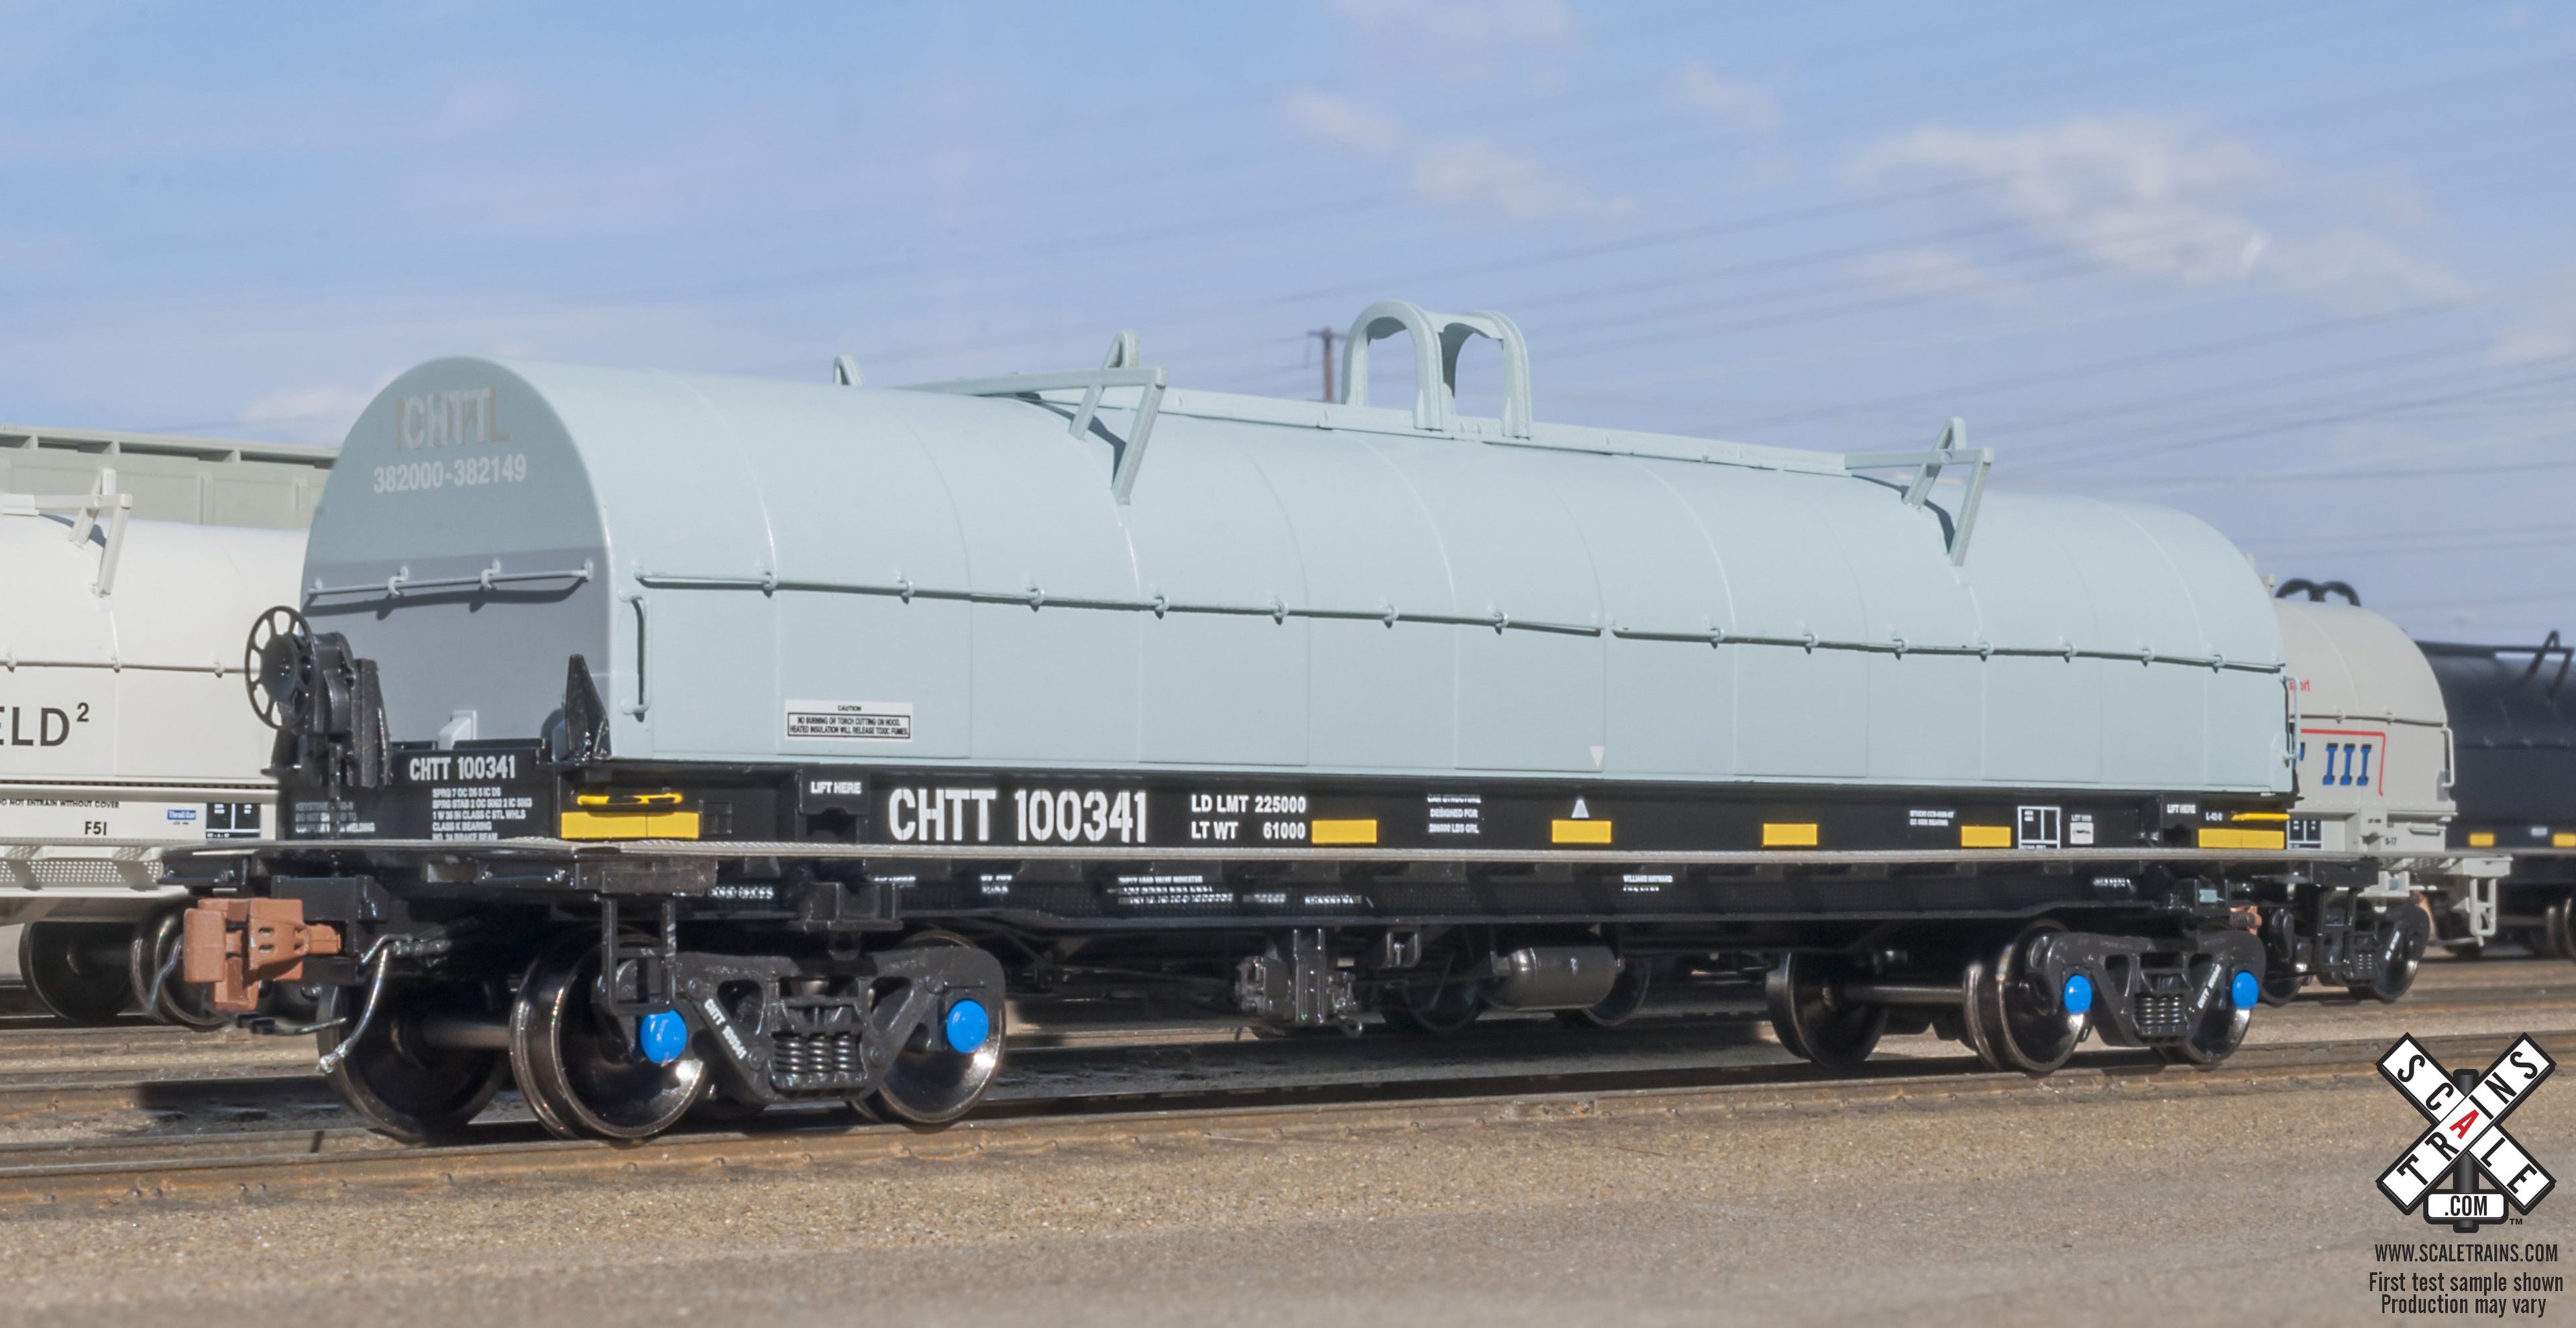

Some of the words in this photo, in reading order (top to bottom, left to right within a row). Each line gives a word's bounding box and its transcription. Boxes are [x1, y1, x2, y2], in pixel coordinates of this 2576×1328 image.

[374, 453, 527, 494] 382000-382149
[806, 716, 828, 724] BURNING
[838, 717, 854, 725] TORCH
[840, 726, 851, 734] WILL
[853, 726, 874, 734] RELEASE
[409, 757, 451, 781] CHTT
[458, 755, 516, 780] 100341
[811, 781, 833, 793] LIFT
[834, 781, 861, 793] HERE
[60, 799, 93, 808] WITHOUT
[1191, 794, 1212, 812] LD
[1216, 795, 1248, 812] LMT
[1254, 795, 1307, 813] 225000
[462, 810, 484, 820] CLASS
[492, 810, 505, 819] STL
[505, 810, 526, 819] WHLS
[889, 788, 997, 842] CHTT
[1015, 790, 1147, 844] 100341
[1430, 808, 1463, 818] DESIGNED
[432, 822, 454, 832] CLASS
[462, 821, 492, 831] BEARING
[1191, 822, 1210, 839] LT
[1213, 822, 1238, 839] WT
[1263, 822, 1307, 840] 61000
[704, 998, 726, 1026] CHTT
